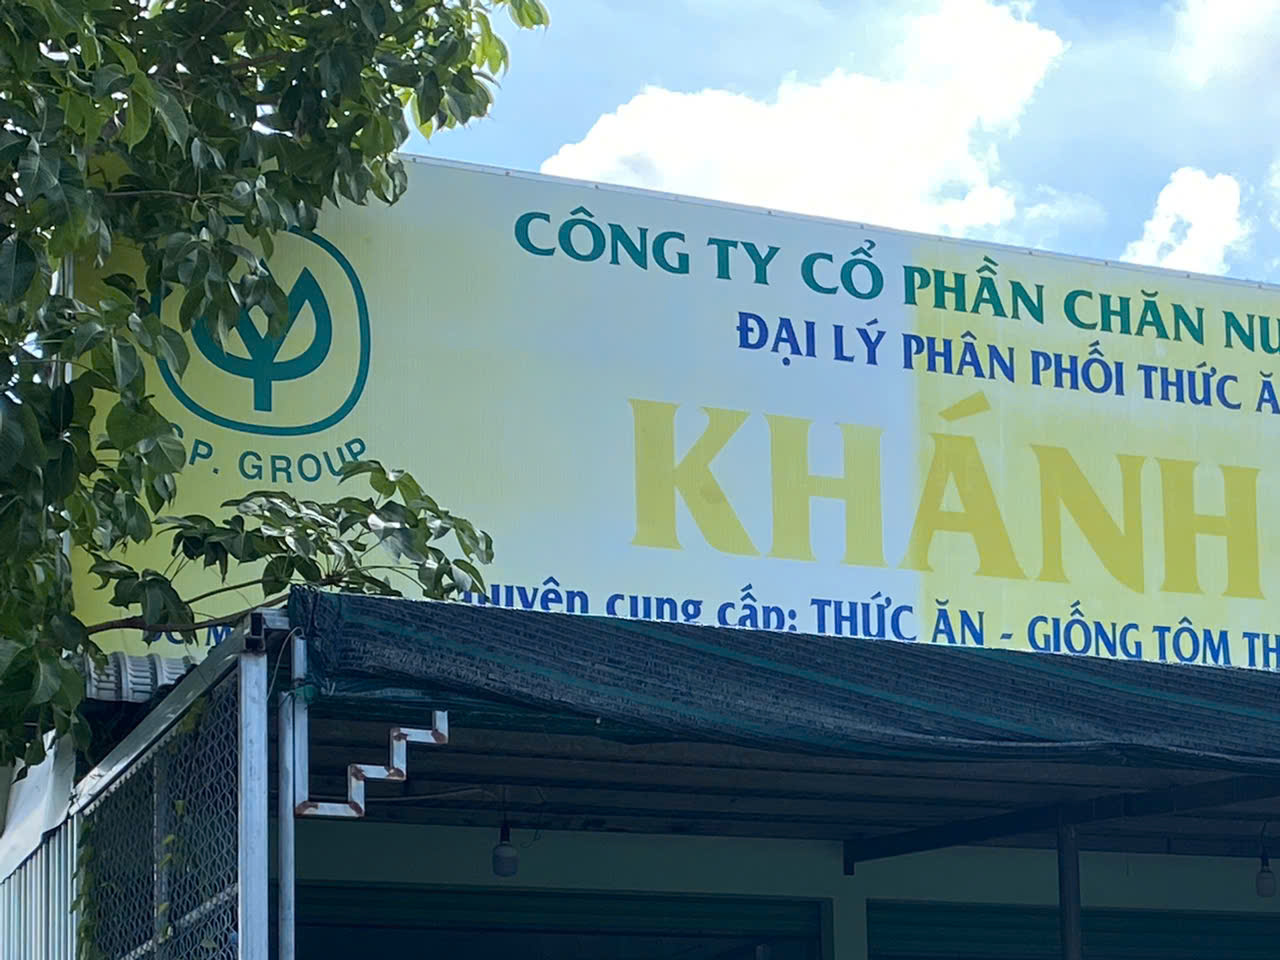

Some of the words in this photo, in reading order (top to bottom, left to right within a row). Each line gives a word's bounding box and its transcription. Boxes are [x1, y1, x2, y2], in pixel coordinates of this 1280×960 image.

[515, 206, 690, 276] CÔNG
[705, 236, 780, 286] TY
[801, 240, 884, 301] CỔ
[904, 256, 1045, 324] PHẦN
[1063, 288, 1205, 346] CHĂN
[737, 311, 818, 366] ĐẠI
[834, 318, 886, 365] LÝ
[901, 331, 1016, 384] PHÂN
[1031, 338, 1124, 397] PHỐI
[1138, 362, 1241, 410] THỨC
[238, 438, 367, 484] GROUP
[631, 391, 1264, 602] KHÁNH
[811, 591, 917, 642] THỨC
[931, 598, 985, 646] ĂN
[1027, 600, 1142, 660] GIỐNG
[1152, 616, 1232, 664] TÔM
